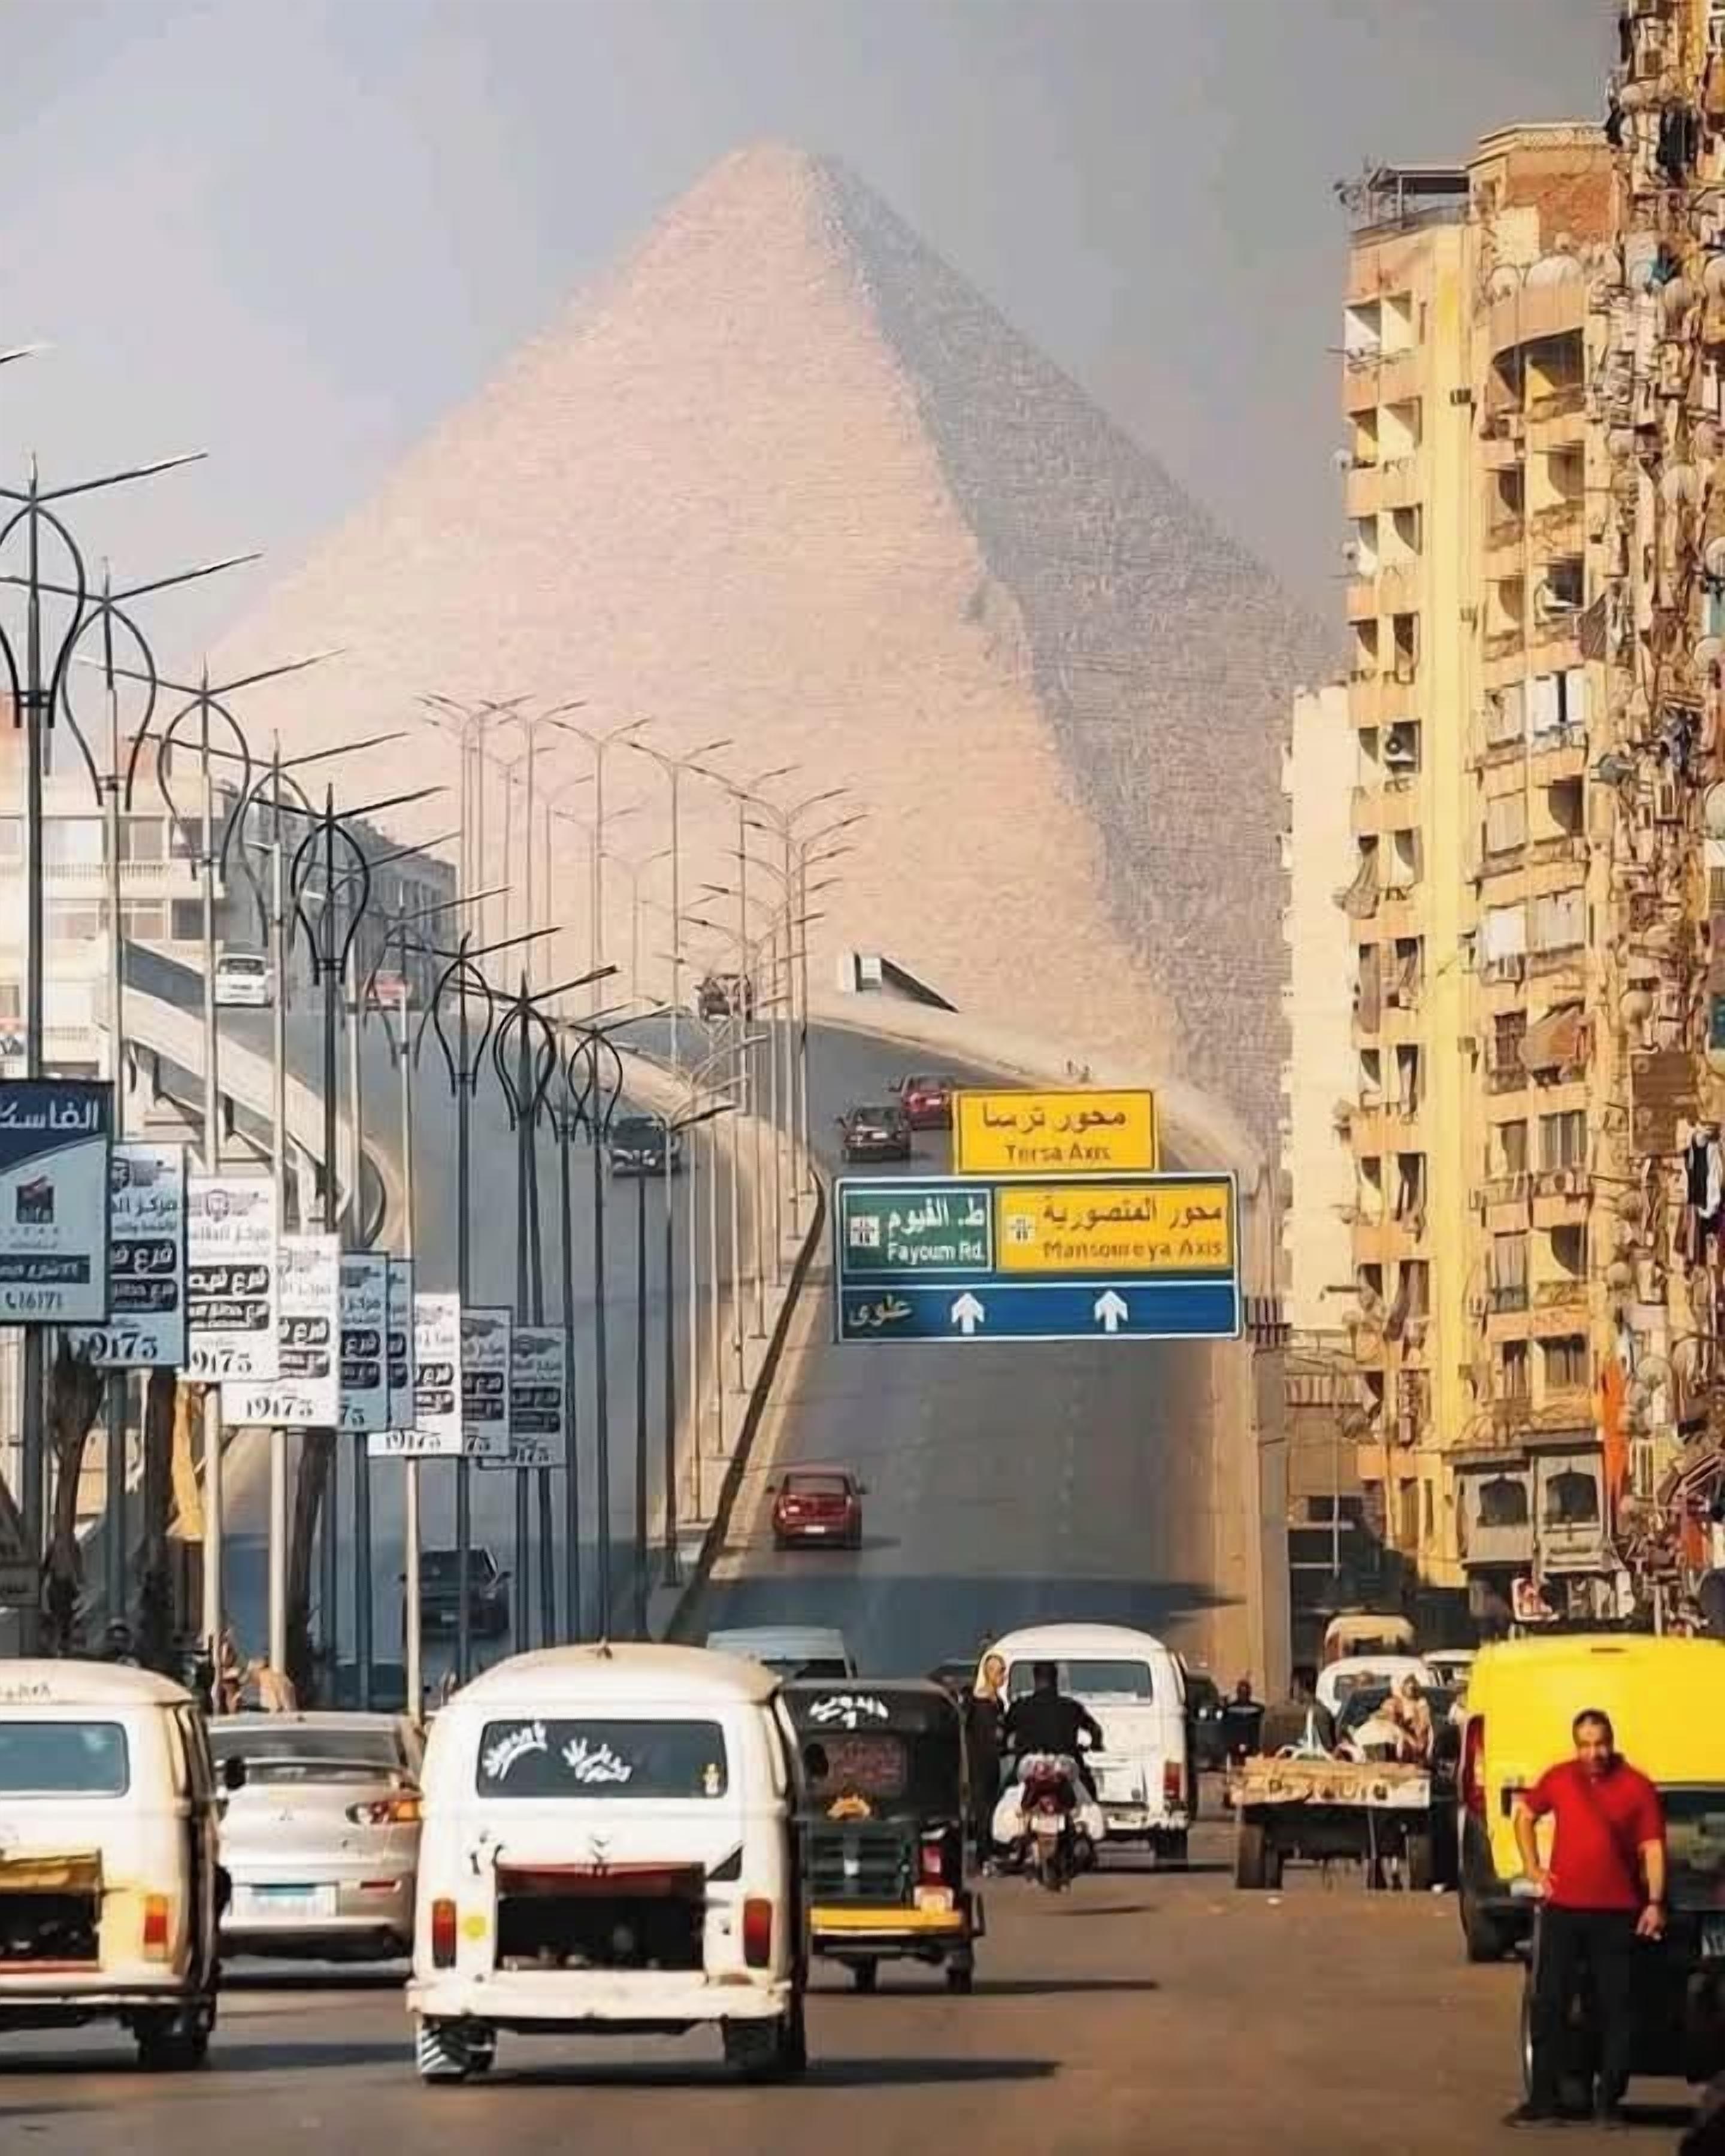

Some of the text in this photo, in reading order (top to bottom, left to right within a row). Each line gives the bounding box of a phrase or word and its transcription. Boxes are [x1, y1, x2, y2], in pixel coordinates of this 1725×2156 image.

[982, 1101, 1127, 1134] محور ترسا
[1070, 1142, 1111, 1161] Axis
[888, 1197, 950, 1240] الفيوم
[1042, 1195, 1222, 1232] محور المنصورية
[888, 1241, 957, 1266] Fayoum
[1043, 1239, 1222, 1261] Mansoureya Axis
